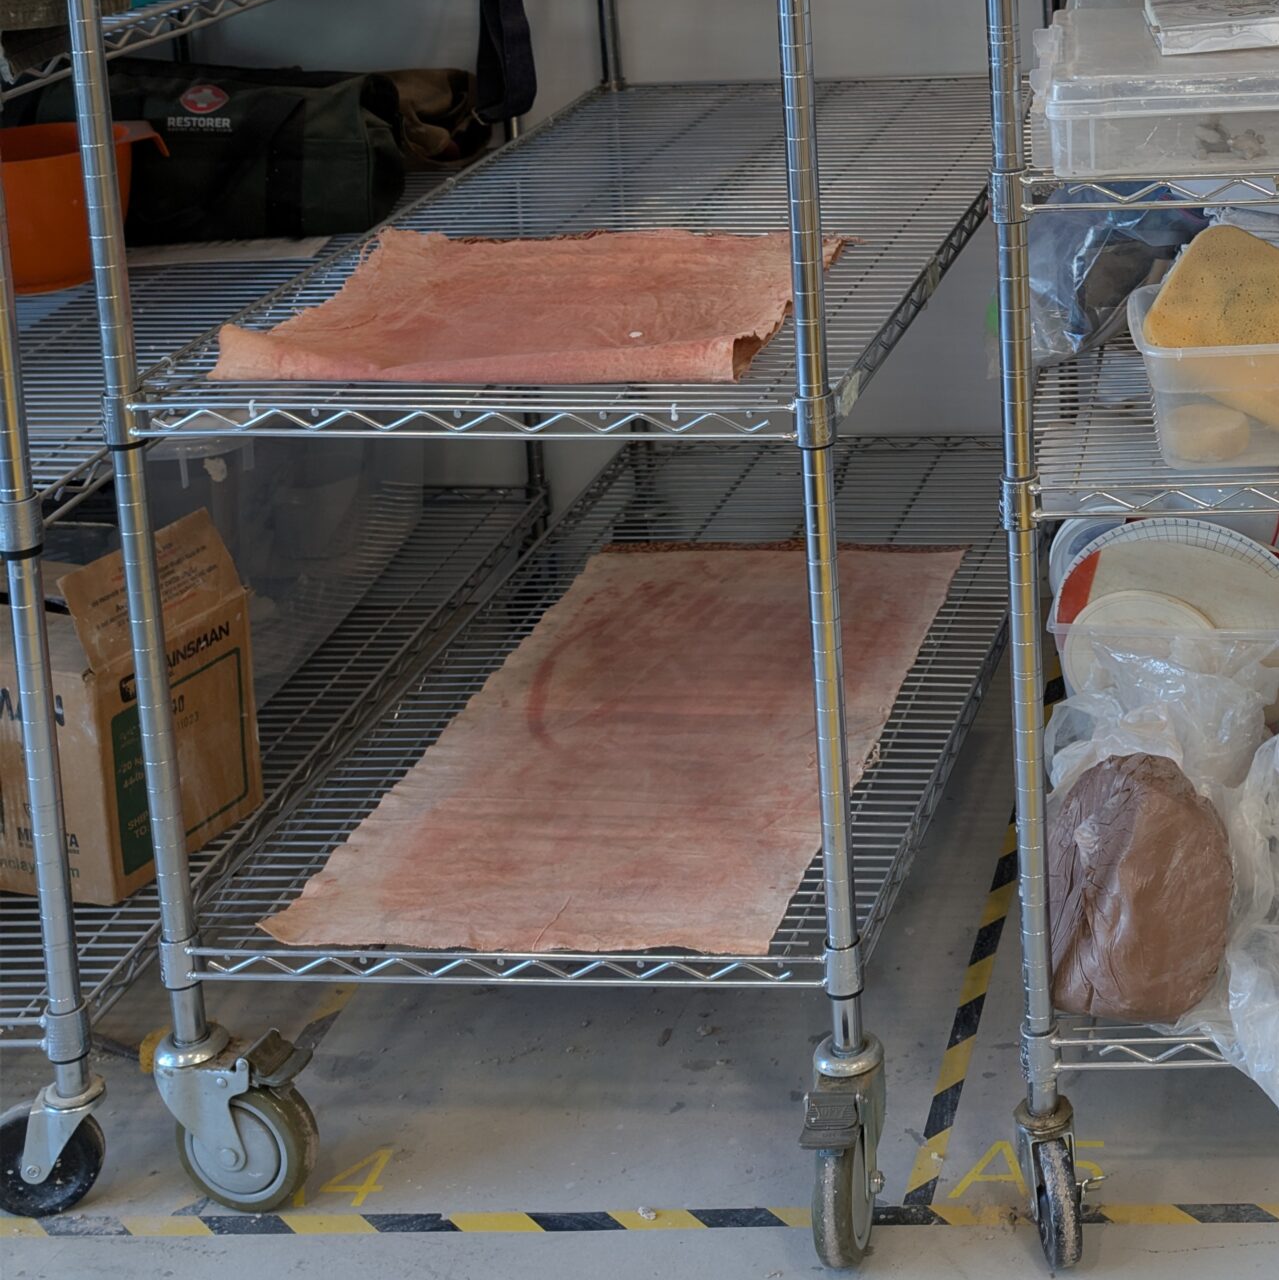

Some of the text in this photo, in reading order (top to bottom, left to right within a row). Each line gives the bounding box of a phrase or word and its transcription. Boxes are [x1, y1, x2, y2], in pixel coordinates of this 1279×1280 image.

[167, 116, 231, 128] RESTORER
[165, 621, 230, 668] AINSMAN
[293, 1148, 395, 1208] 4
